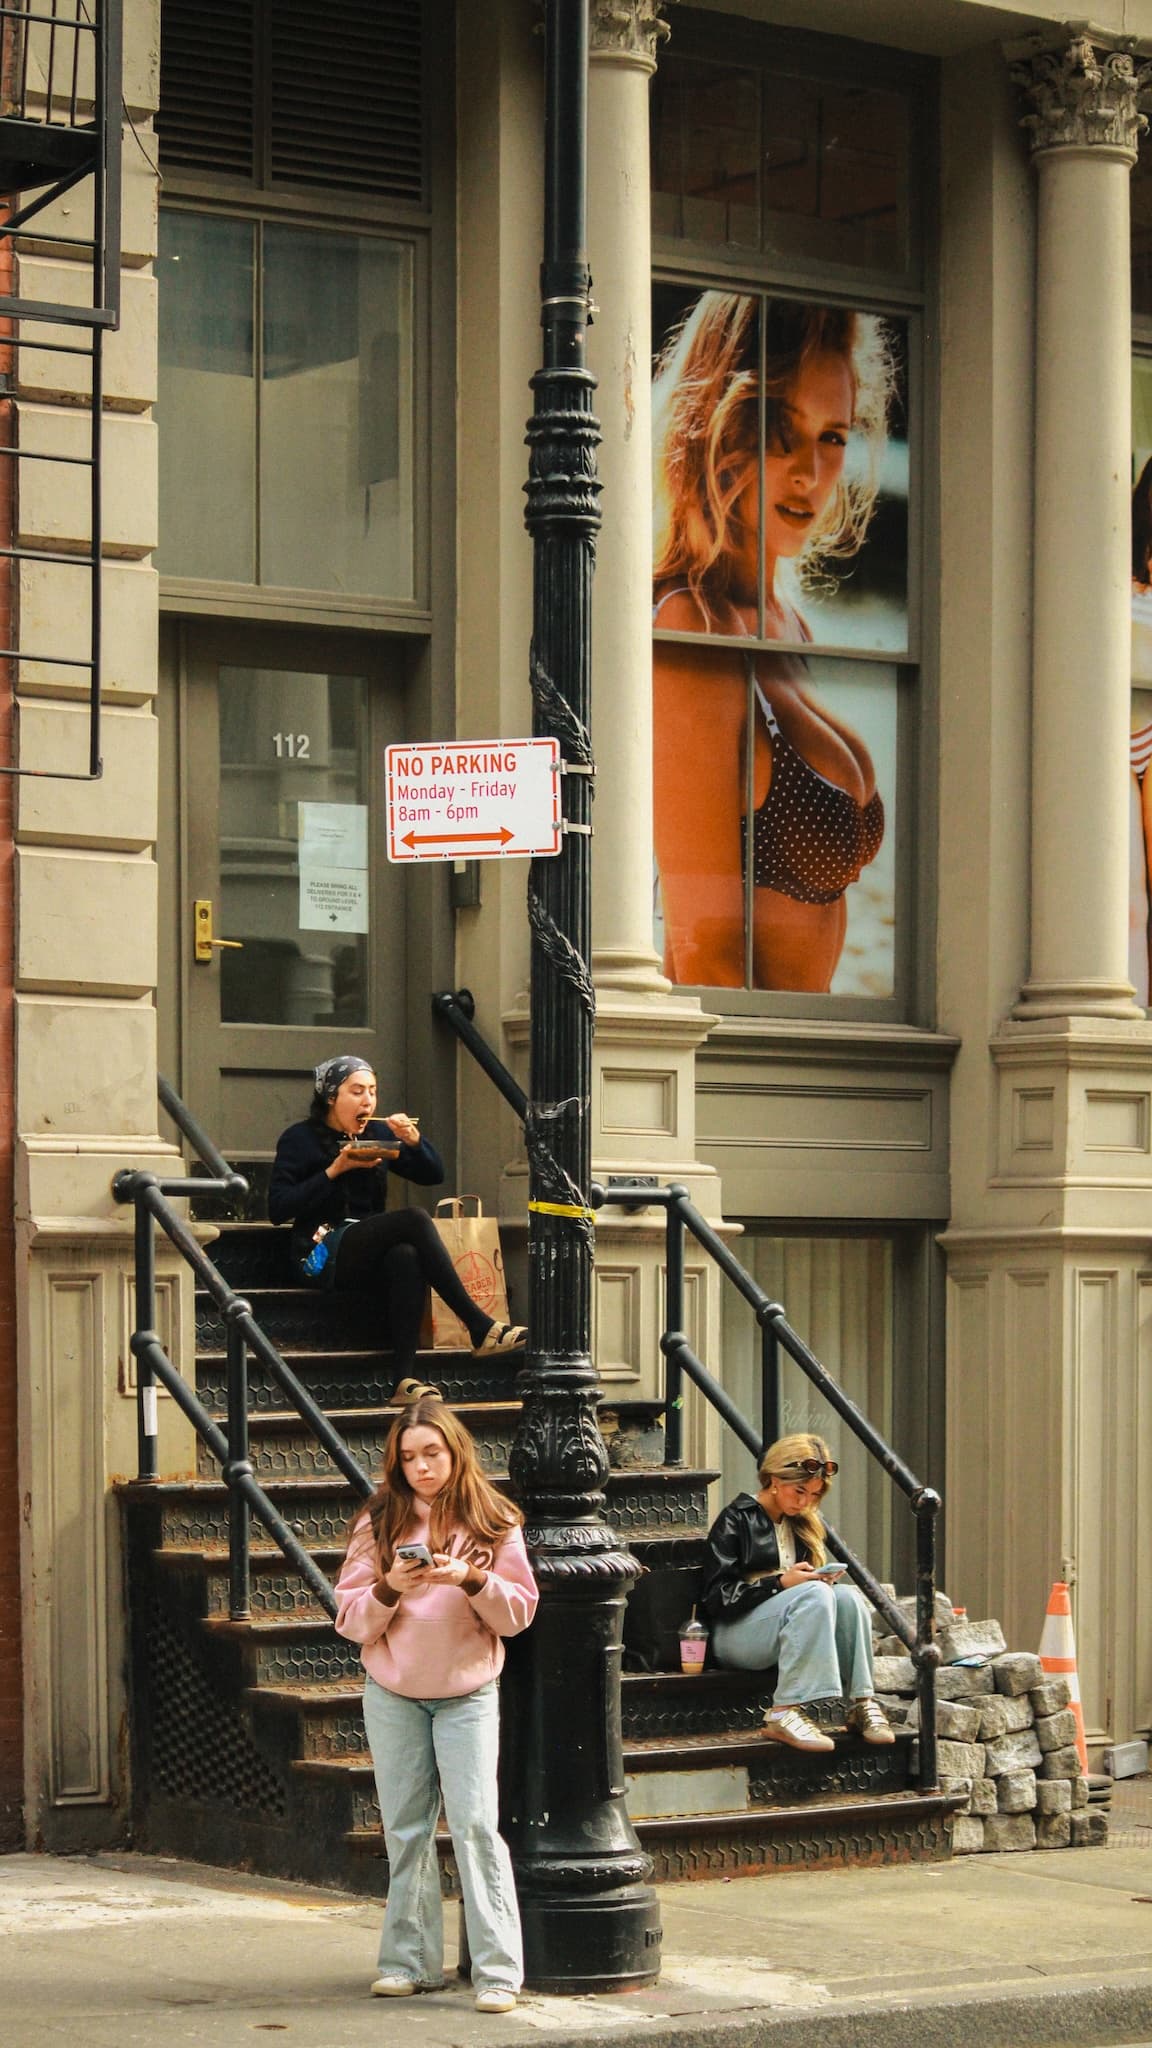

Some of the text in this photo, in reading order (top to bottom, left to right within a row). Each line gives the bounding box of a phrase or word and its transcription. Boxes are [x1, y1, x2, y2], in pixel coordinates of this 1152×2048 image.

[272, 732, 310, 759] 112
[397, 753, 517, 777] NO PARKING
[397, 784, 455, 802] Monday
[471, 781, 517, 799] Friday
[399, 805, 430, 822] 8am
[446, 803, 479, 823] 6pm
[465, 1276, 492, 1293] RADER
